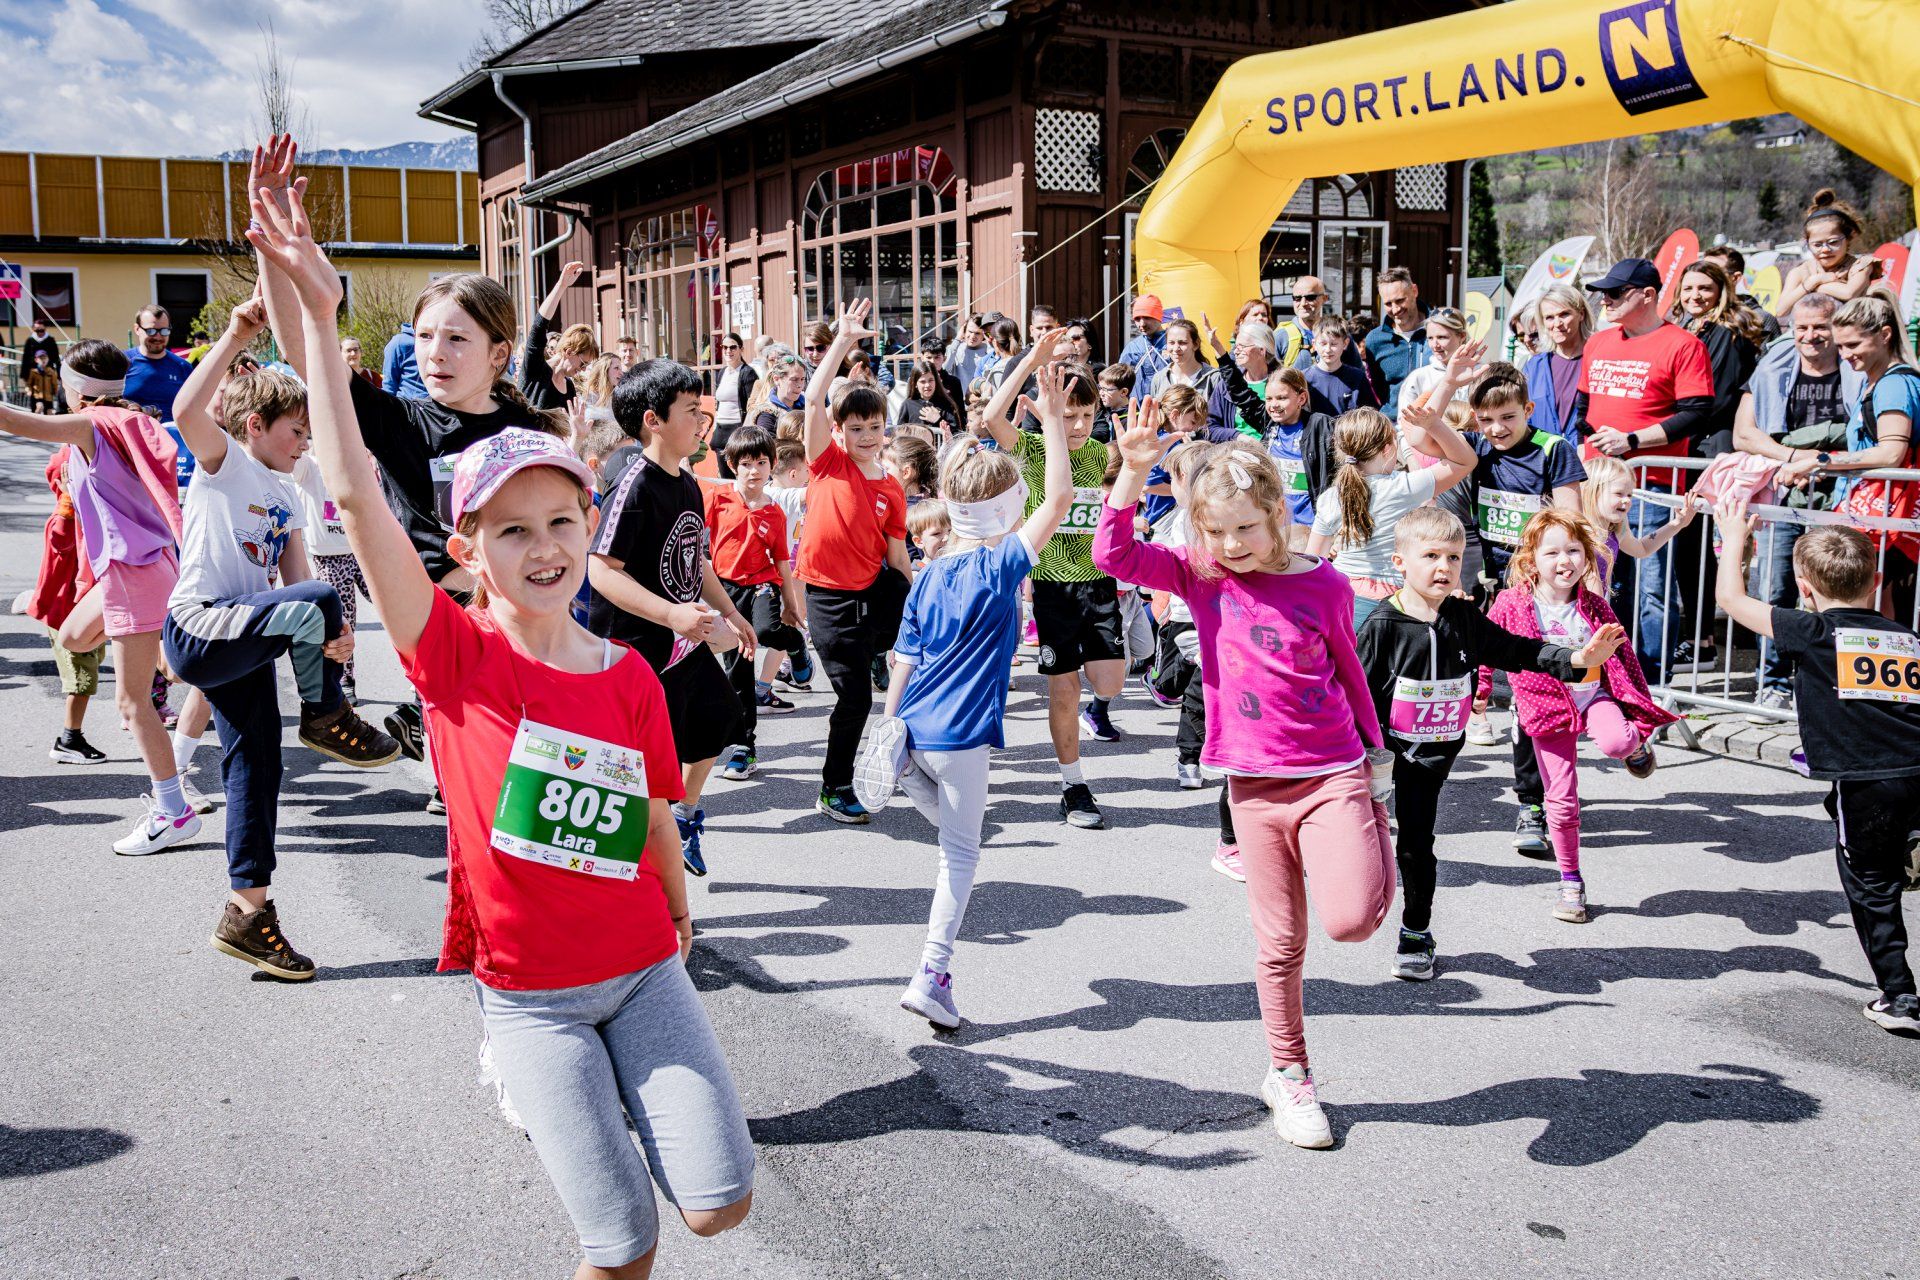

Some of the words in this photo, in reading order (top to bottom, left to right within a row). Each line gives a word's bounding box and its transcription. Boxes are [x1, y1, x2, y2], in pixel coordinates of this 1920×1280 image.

[1608, 6, 1677, 81] N
[1266, 47, 1585, 135] SPORT.LAND.
[1487, 507, 1522, 528] 859
[1487, 524, 1519, 537] Florian
[1853, 655, 1920, 691] 966
[1415, 701, 1461, 723] 752
[1411, 721, 1459, 735] Leopold
[538, 779, 628, 835] 805
[551, 826, 597, 854] Lara
